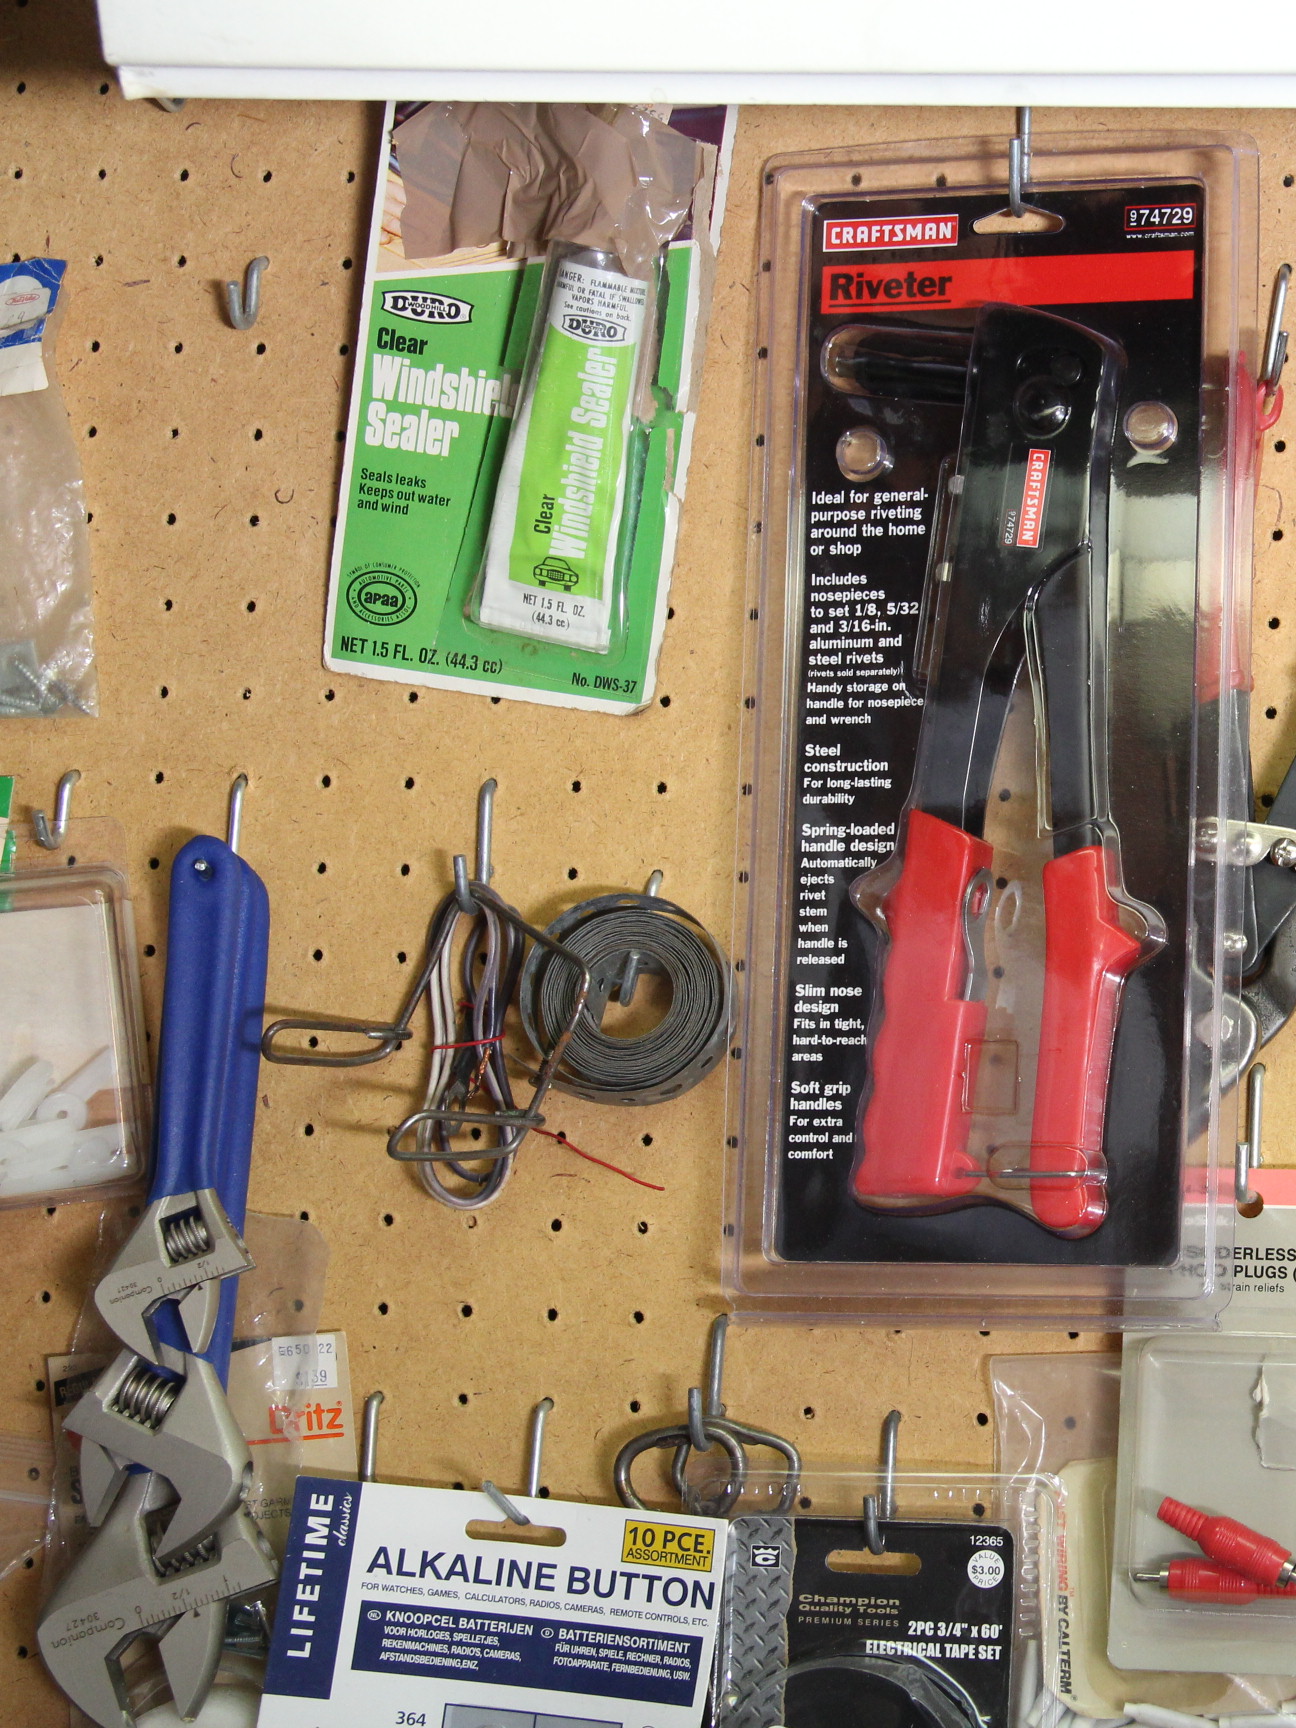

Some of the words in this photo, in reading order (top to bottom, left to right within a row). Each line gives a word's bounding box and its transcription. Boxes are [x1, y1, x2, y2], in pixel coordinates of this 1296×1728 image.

[830, 222, 953, 244] CRAFTSMAN
[829, 272, 952, 301] Riveter
[390, 295, 461, 320] DURO
[408, 300, 447, 312] WOODHILL
[377, 328, 428, 355] Clear
[570, 347, 617, 429] Sealer
[365, 401, 459, 457] Sealer
[360, 468, 392, 488] Seals
[395, 472, 426, 489] leaks
[358, 483, 394, 503] Keeps
[396, 488, 415, 502] out
[418, 493, 451, 508] water
[548, 430, 602, 558] Windshield
[812, 491, 844, 505] Ideal
[850, 490, 869, 503] for
[874, 488, 928, 505] general-
[1022, 453, 1045, 540] CRAFTSMAN
[357, 498, 378, 512] and
[381, 501, 409, 516] wind
[533, 493, 556, 535] Clear
[811, 509, 866, 524] purpose
[871, 505, 922, 520] riveting
[810, 524, 856, 538] around
[862, 524, 883, 536] the
[889, 523, 925, 536] home
[810, 543, 824, 555] or
[830, 542, 861, 556] shop
[811, 573, 867, 586] Includes
[364, 591, 399, 607] apaa
[810, 588, 885, 602] nosepieces
[810, 605, 823, 618] to
[829, 605, 849, 617] set
[855, 603, 881, 618] 1/8,
[887, 602, 919, 615] 5/32
[810, 620, 833, 633] and
[839, 619, 891, 633] 3/16-in.
[809, 637, 873, 650] aluminum
[879, 635, 902, 647] and
[341, 636, 368, 654] NET
[372, 641, 389, 658] 1.5
[393, 644, 413, 662] FL.
[419, 648, 439, 665] OZ.
[446, 651, 478, 671] (44.3
[482, 657, 503, 675] cc)
[809, 652, 841, 665] steel
[847, 651, 884, 664] rivets
[571, 672, 590, 688] No.
[594, 675, 637, 694] DWS-37
[805, 744, 840, 757] Steel
[804, 759, 888, 772] construction
[802, 823, 894, 838] Spring-loaded
[801, 840, 845, 852] handle
[850, 839, 895, 853] design
[795, 984, 825, 997] Slim
[830, 987, 862, 996] nose
[794, 1001, 838, 1014] design
[791, 1081, 820, 1094] Soft
[824, 1081, 851, 1096] grip
[790, 1098, 842, 1110] handles
[1234, 1265, 1288, 1279] PLUGS
[1254, 1283, 1285, 1292] reliefs
[332, 1492, 353, 1547] classics
[629, 1526, 655, 1548] 10
[663, 1533, 711, 1555] PCE.
[969, 1535, 1004, 1547] 12365
[626, 1548, 710, 1568] ASSORTMENT
[972, 1552, 1001, 1564] VALUE
[286, 1493, 335, 1658] LIFETIME
[367, 1546, 558, 1592] ALKALINE
[566, 1567, 715, 1610] BUTTON
[971, 1564, 1001, 1576] $3.00
[973, 1575, 1000, 1587] PRICE
[361, 1582, 379, 1590] FOR
[382, 1584, 425, 1596] WATCHES,
[428, 1589, 460, 1600] GAMES,
[465, 1592, 528, 1607] CALCULATORS,
[529, 1598, 562, 1613] RADIOS,
[564, 1603, 605, 1615] CAMERAS,
[610, 1608, 643, 1619] REMOTE
[645, 1612, 690, 1625] CONTROLS,
[692, 1618, 709, 1627] ETC.
[799, 1594, 900, 1606] Champion
[1058, 1594, 1070, 1613] BY
[799, 1604, 852, 1615] Quality
[856, 1606, 899, 1614] Tools
[386, 1611, 456, 1628] KNOOPCEL
[459, 1617, 533, 1635] BATTERIJEN
[798, 1616, 851, 1625] PREMIUM
[858, 1618, 899, 1627] SERIES
[908, 1621, 934, 1637] 2PC
[938, 1621, 968, 1638] 3/4"
[971, 1626, 978, 1638] x
[980, 1624, 1003, 1639] 60'
[51, 1617, 126, 1649] Companion
[559, 1628, 690, 1654] BATTERIENSORTIMENT
[866, 1640, 942, 1657] ELECTRICAL
[944, 1643, 976, 1659] TAPE
[978, 1645, 1002, 1660] SET
[1058, 1615, 1072, 1695] CALTERM
[395, 1711, 427, 1726] 364
